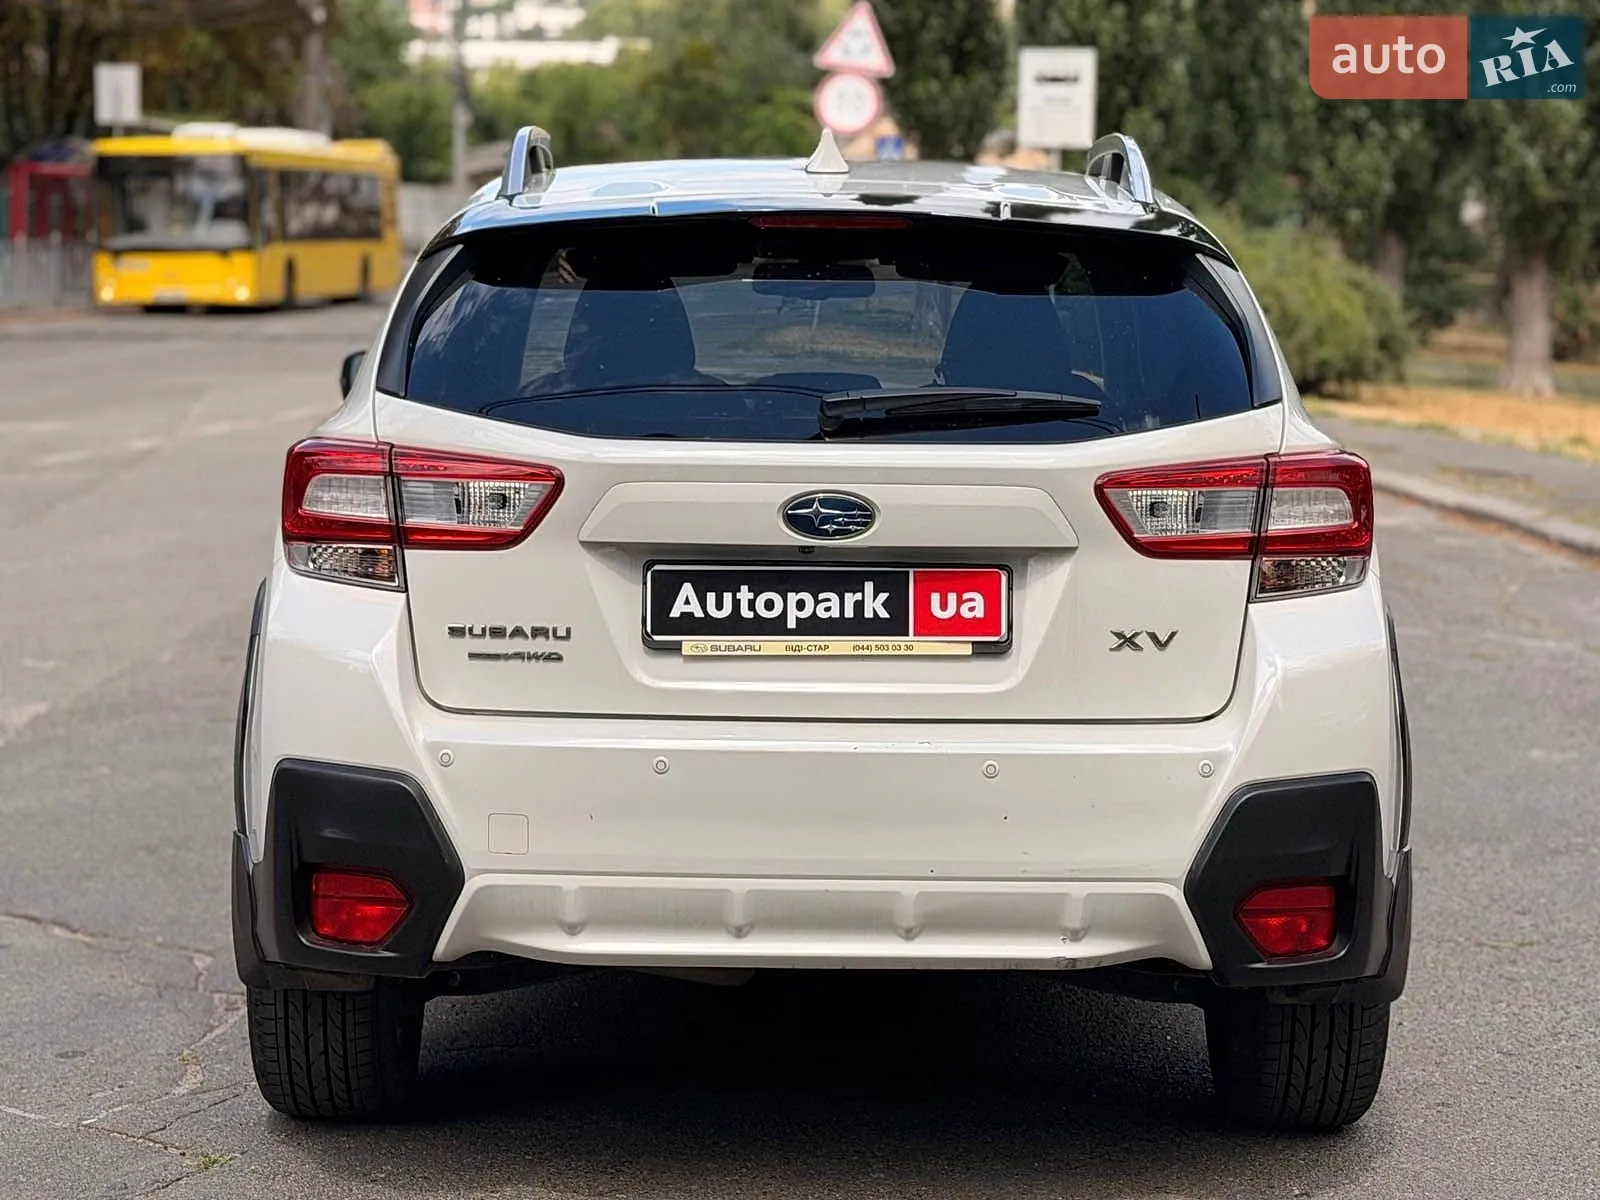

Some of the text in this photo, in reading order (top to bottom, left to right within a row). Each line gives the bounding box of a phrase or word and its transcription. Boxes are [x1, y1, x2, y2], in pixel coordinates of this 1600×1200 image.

[669, 581, 891, 629] Autopark
[930, 592, 985, 618] ua
[447, 624, 572, 641] SUBARU
[1108, 630, 1179, 652] XV
[709, 644, 762, 652] SUBARU
[852, 644, 872, 652] (044)
